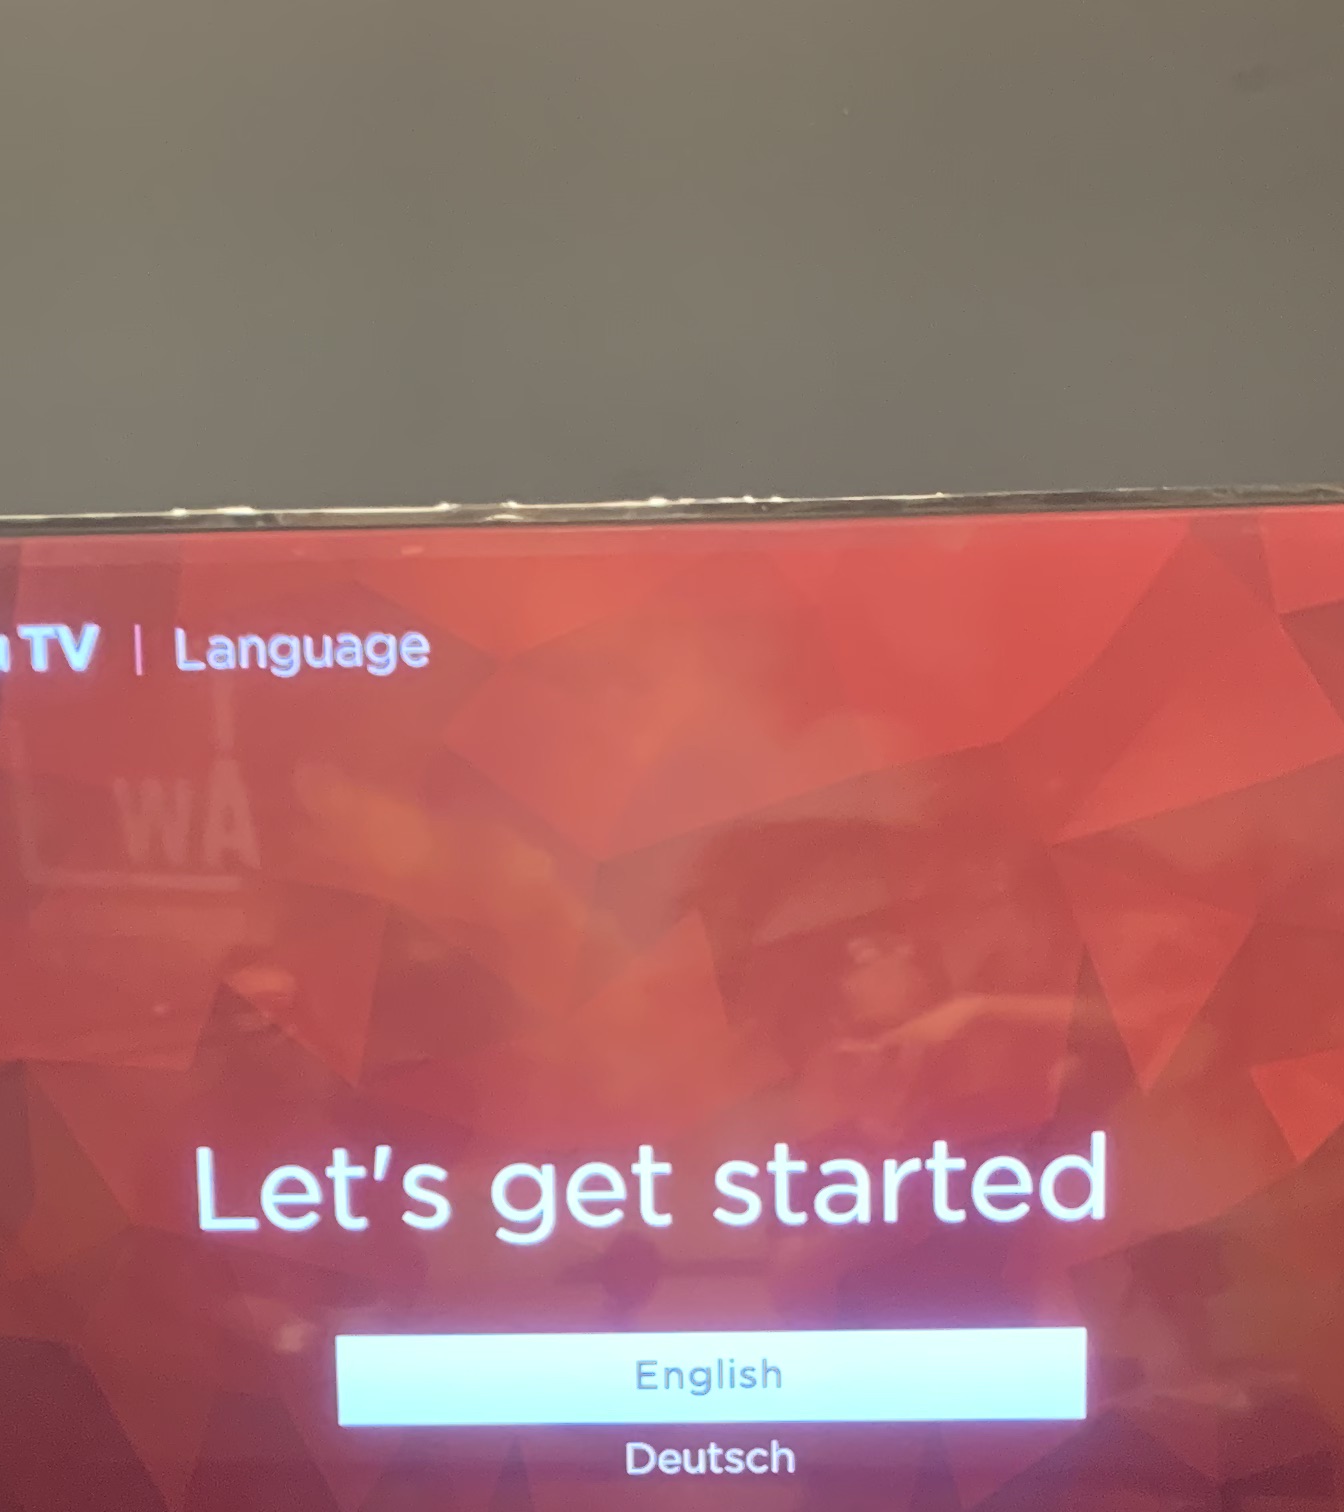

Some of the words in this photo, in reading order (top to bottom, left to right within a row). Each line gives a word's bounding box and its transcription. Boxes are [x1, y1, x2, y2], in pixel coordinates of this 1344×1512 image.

[16, 623, 102, 673] TV
[174, 627, 432, 678] Language
[195, 1144, 453, 1233] Let's
[489, 1143, 674, 1247] get
[711, 1130, 1108, 1228] started
[635, 1357, 783, 1397] English
[625, 1438, 797, 1476] Deutsch
